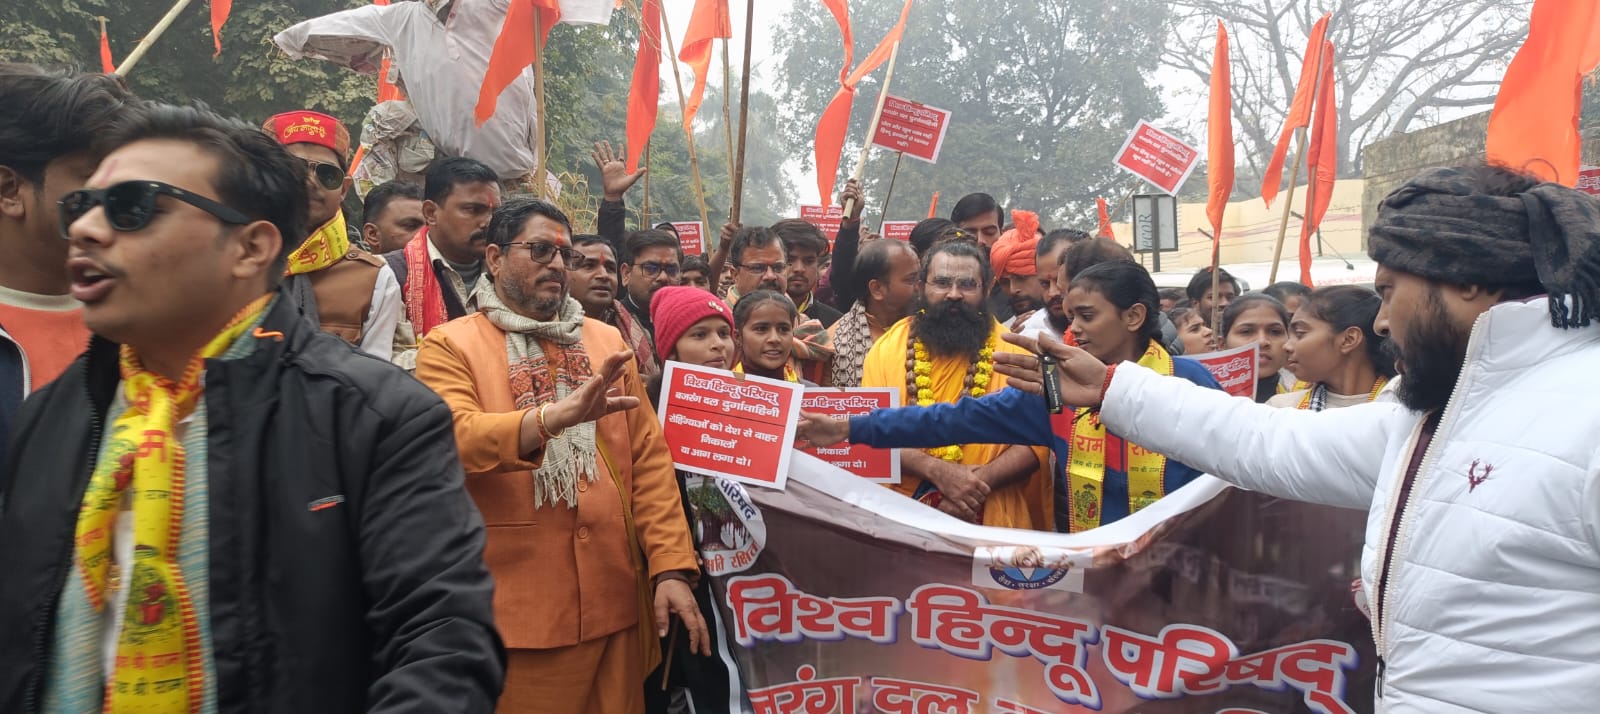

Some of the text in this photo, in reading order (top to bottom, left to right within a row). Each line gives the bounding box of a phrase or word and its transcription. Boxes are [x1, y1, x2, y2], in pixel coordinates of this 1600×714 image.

[683, 373, 780, 404] विश्व हिन्दू परिषद्
[675, 389, 779, 419] बजरंग दल दुर्गावाहिनी
[814, 396, 845, 410] हिन्दू
[844, 396, 880, 409] परिषद्
[709, 421, 722, 431] को
[724, 424, 740, 434] देश
[742, 427, 752, 437] से
[754, 431, 777, 442] बाहर
[1076, 435, 1104, 453] राम
[680, 446, 689, 454] या
[691, 448, 710, 457] आग
[712, 452, 733, 462] लगा
[726, 574, 1357, 714] विश्व हिन्दू परिषद्
[870, 677, 979, 714] दल
